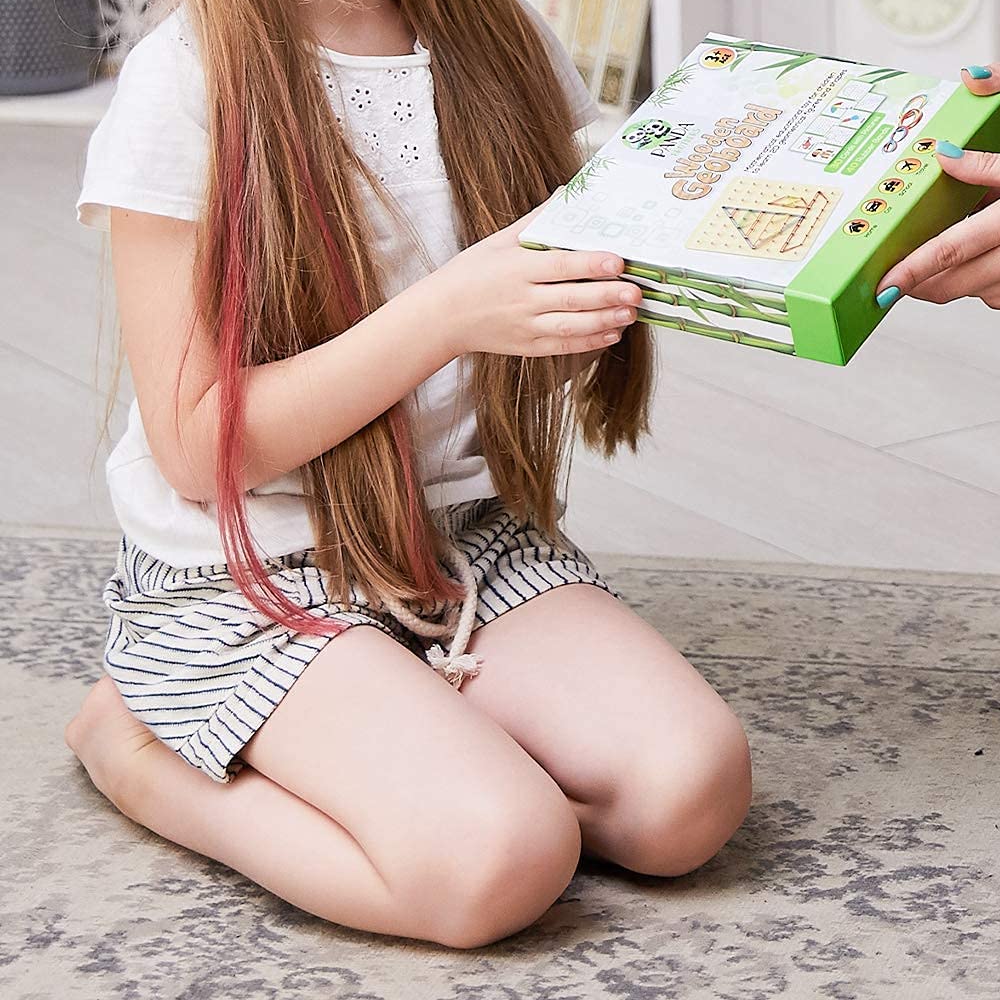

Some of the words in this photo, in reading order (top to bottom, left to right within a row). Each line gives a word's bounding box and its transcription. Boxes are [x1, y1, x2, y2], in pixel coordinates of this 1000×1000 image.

[651, 123, 695, 157] PANDA
[664, 117, 740, 178] Wooden
[671, 103, 783, 200] Geoboard
